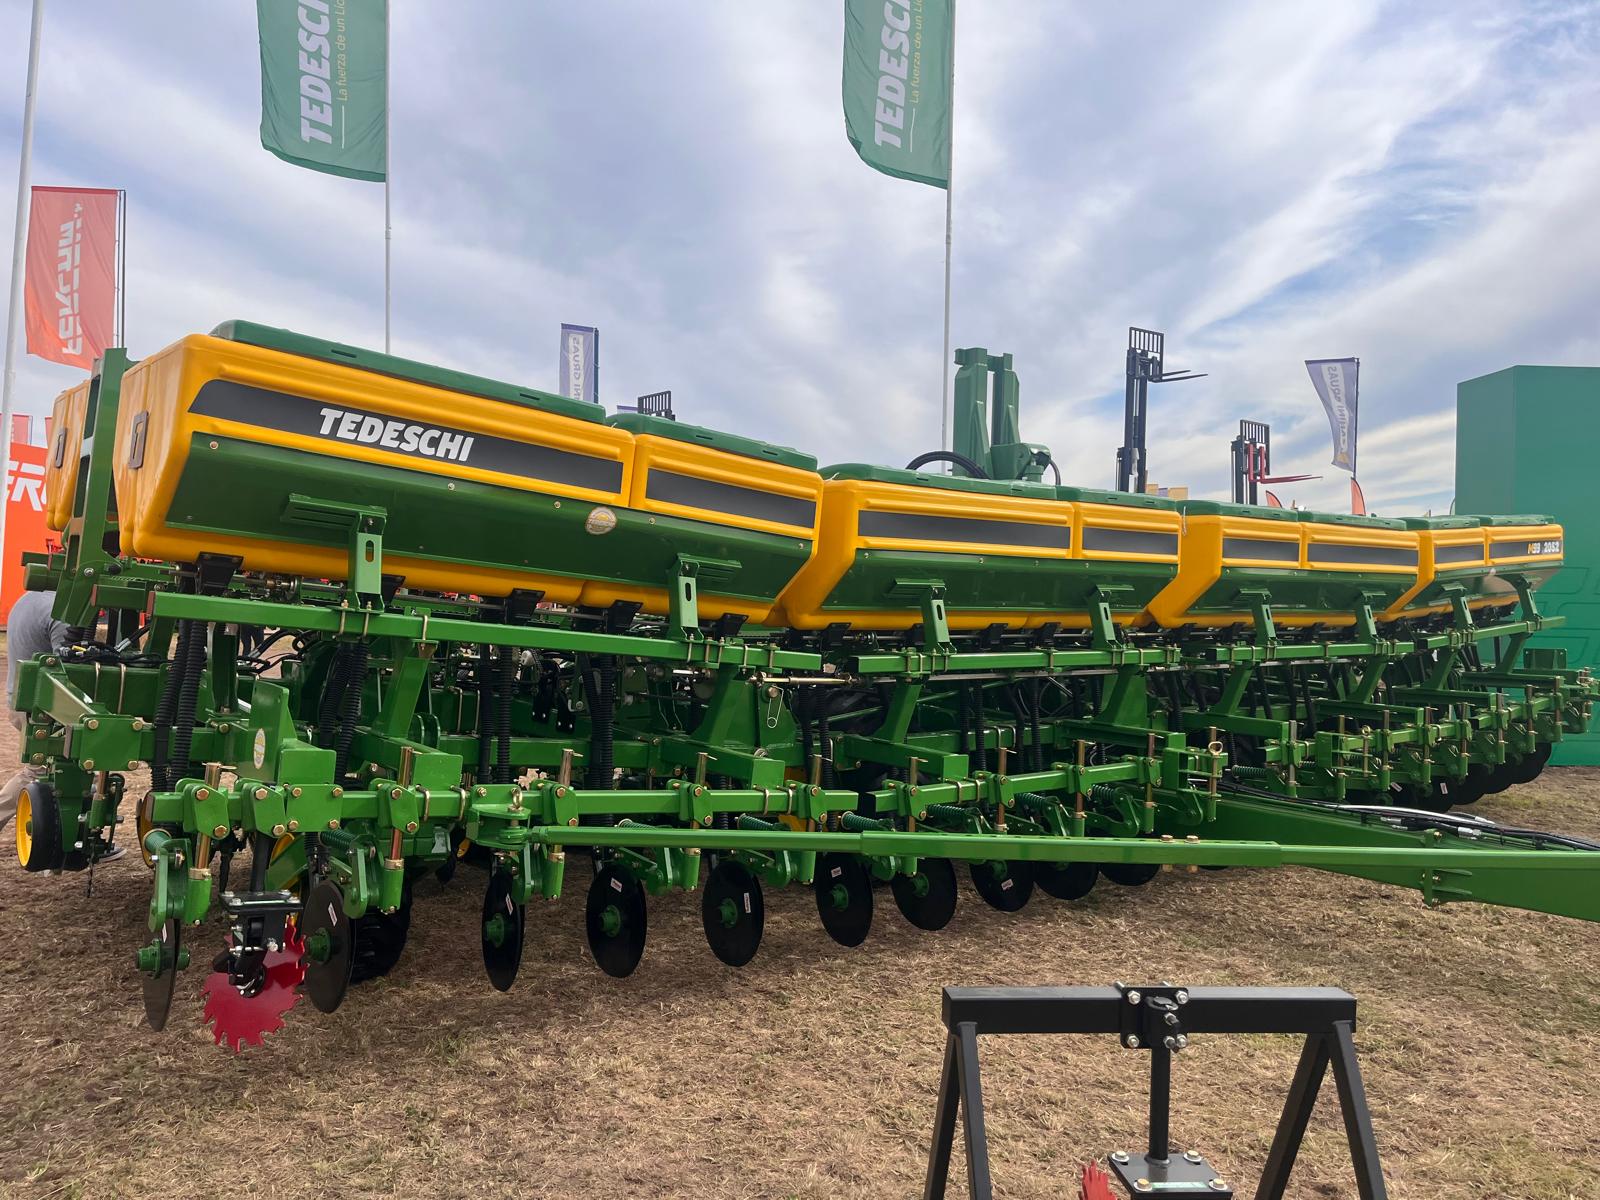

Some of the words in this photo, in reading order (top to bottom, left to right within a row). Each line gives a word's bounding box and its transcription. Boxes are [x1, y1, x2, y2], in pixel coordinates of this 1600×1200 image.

[336, 18, 345, 32] un
[914, 15, 922, 30] un
[335, 34, 346, 51] de
[912, 31, 922, 49] de
[335, 53, 347, 87] fuerza
[910, 51, 921, 88] fuerza
[335, 89, 348, 102] La
[909, 90, 920, 104] La
[319, 407, 475, 462] TEDESCHI
